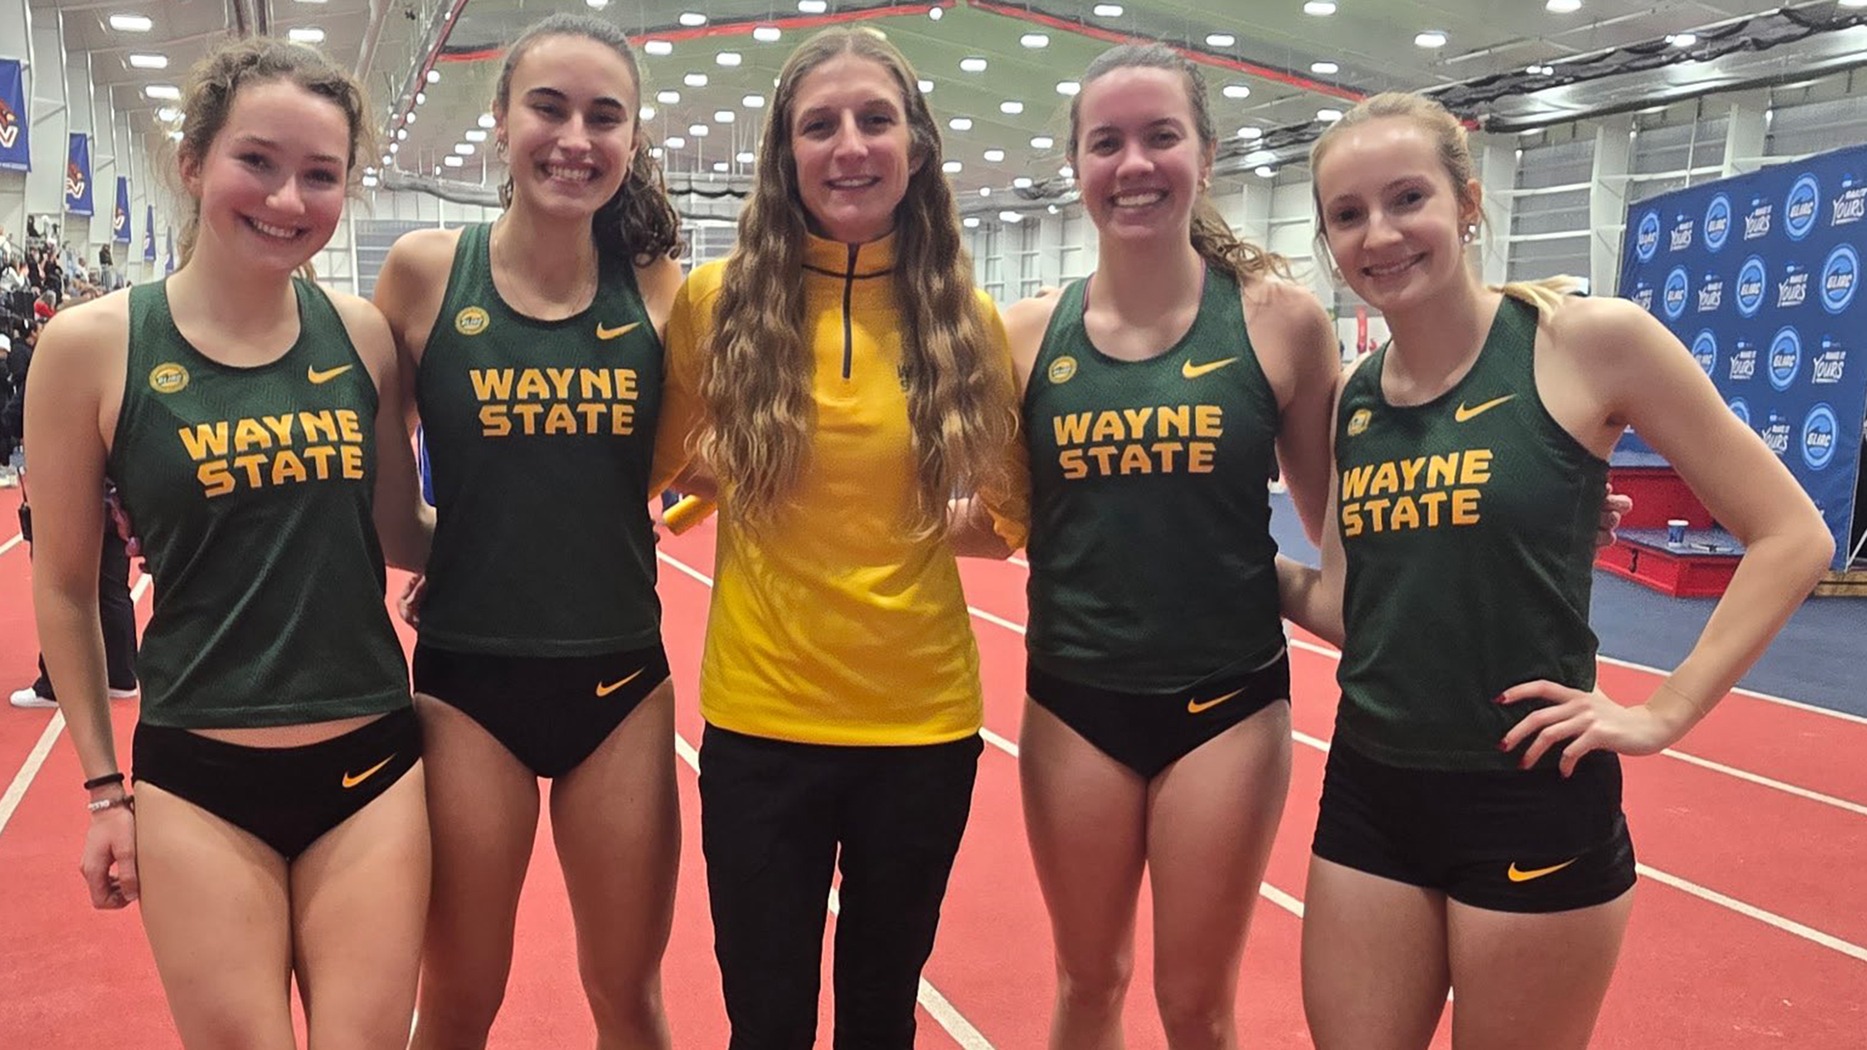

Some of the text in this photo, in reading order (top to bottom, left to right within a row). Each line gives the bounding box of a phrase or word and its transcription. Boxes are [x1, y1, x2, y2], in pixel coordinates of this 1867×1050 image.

[1831, 194, 1865, 227] YOURS
[469, 367, 639, 401] WAYNE
[1812, 353, 1843, 384] YOURS
[178, 409, 364, 462] WAYNE
[478, 402, 635, 437] STATE
[1053, 404, 1224, 447] WAYNE
[197, 445, 365, 499] STATE
[1059, 441, 1216, 480] STATE
[1342, 449, 1493, 501] WAYNE
[1342, 488, 1482, 538] STATE
